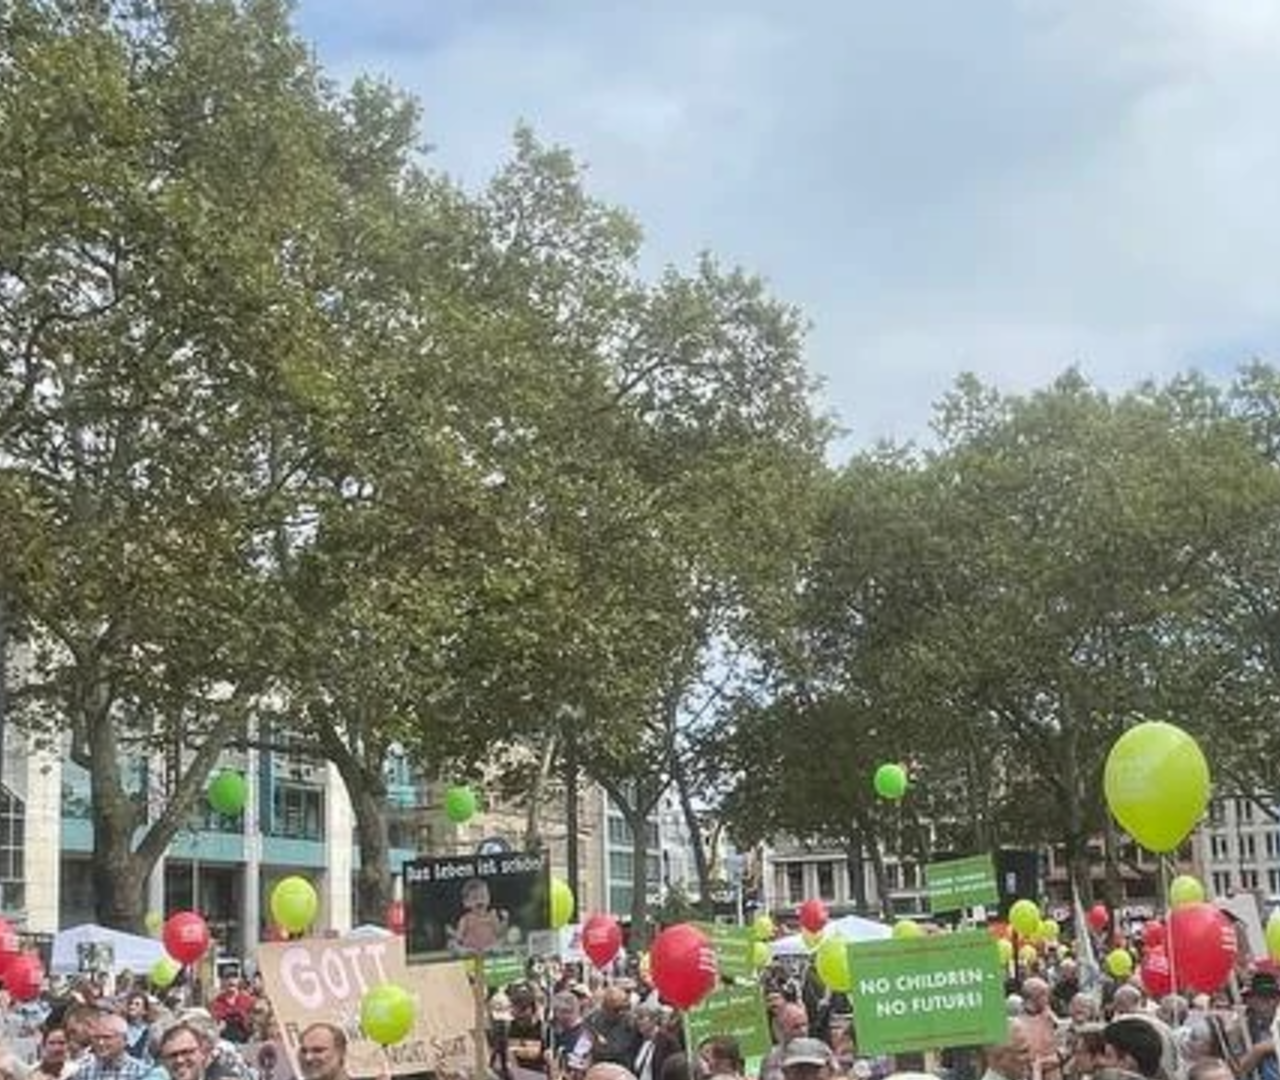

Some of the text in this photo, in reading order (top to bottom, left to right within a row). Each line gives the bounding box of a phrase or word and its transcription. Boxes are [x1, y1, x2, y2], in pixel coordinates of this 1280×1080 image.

[280, 943, 389, 1009] GOTT
[860, 977, 890, 996] NO
[896, 968, 983, 991] CHILDREN
[876, 991, 983, 1017] NO FUTURE!
